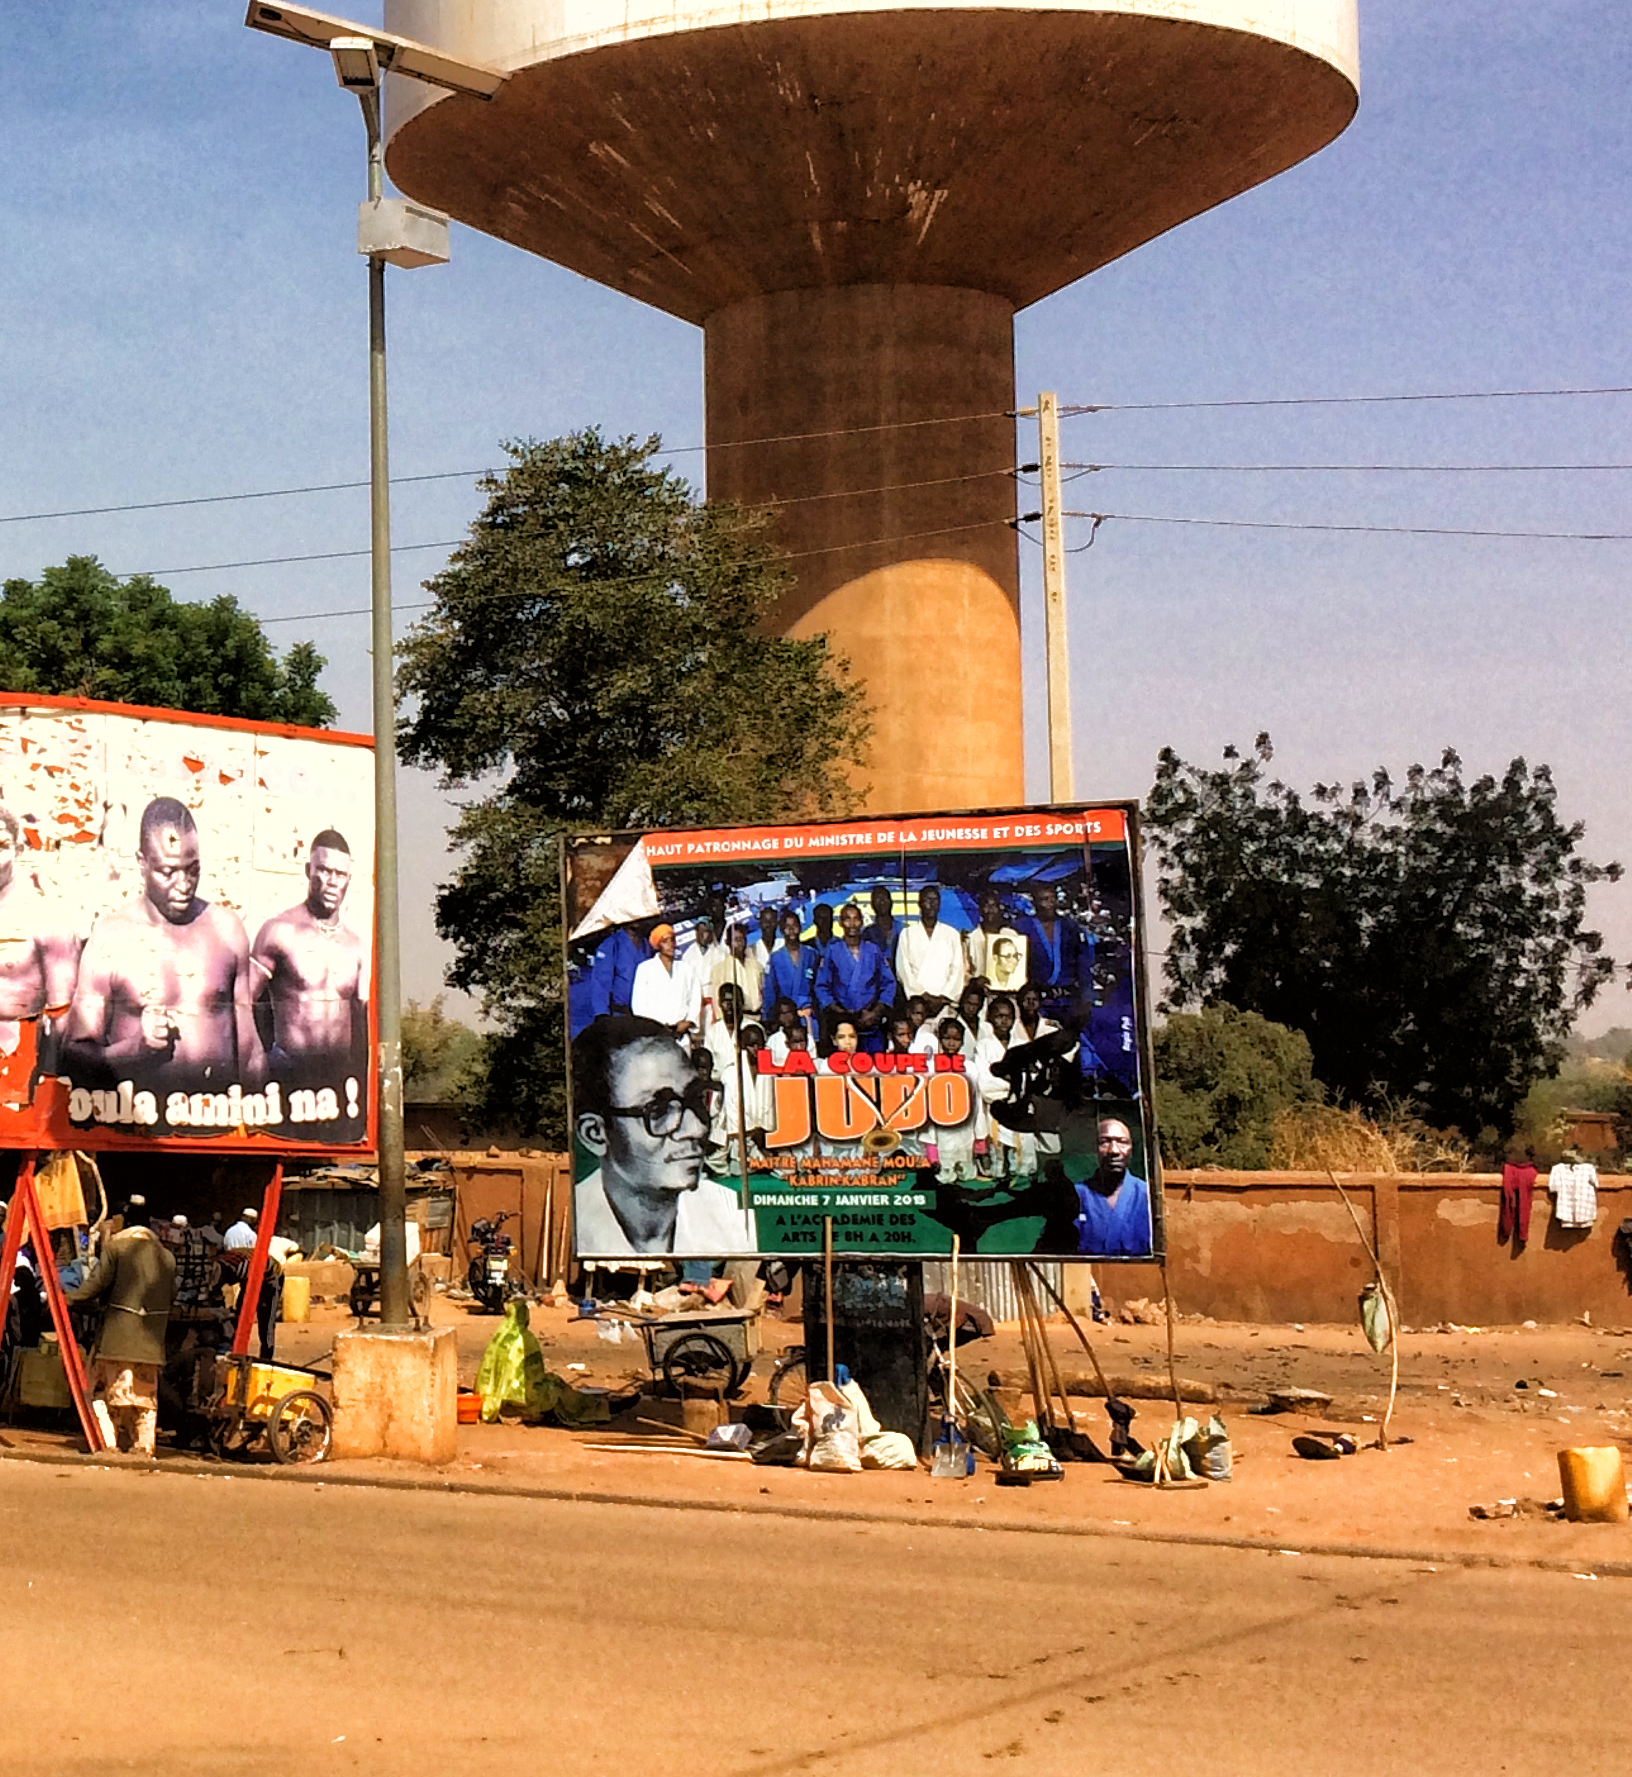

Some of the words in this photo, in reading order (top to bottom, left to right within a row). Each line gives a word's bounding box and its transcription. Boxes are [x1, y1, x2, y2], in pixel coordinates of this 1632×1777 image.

[646, 844, 683, 857] HAUT
[687, 838, 779, 854] PATRONNAGE
[784, 836, 804, 849] DU
[808, 832, 873, 848] MINISTRE
[876, 831, 896, 844] DE
[899, 830, 917, 843] LA
[921, 828, 988, 842] JEUNESSE
[993, 826, 1010, 839] ET
[1014, 824, 1041, 837] DES
[1046, 821, 1102, 836] SPORTS
[756, 1048, 817, 1075] LA
[827, 1050, 928, 1074] COUPE
[934, 1053, 965, 1073] DE
[57, 1075, 159, 1125] oula
[288, 1086, 340, 1123] na
[765, 1071, 971, 1149] JUDO
[753, 1194, 819, 1206] DIMANCHE
[821, 1194, 830, 1206] 7
[835, 1194, 889, 1206] JANVIER
[776, 1214, 786, 1226] A
[889, 1213, 916, 1226] DES
[781, 1231, 817, 1243] ARTS
[869, 1231, 880, 1243] A
